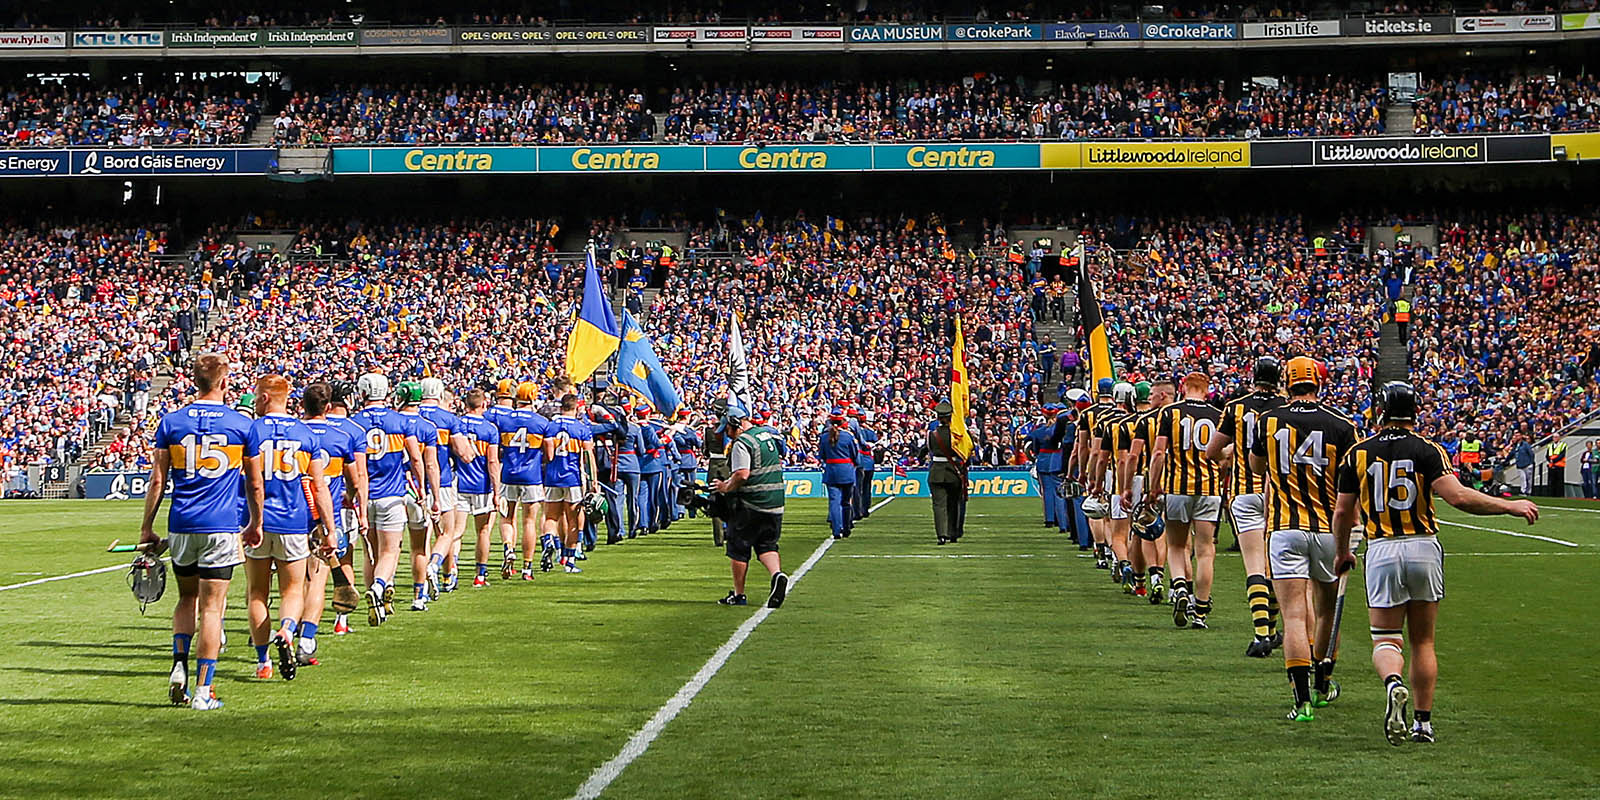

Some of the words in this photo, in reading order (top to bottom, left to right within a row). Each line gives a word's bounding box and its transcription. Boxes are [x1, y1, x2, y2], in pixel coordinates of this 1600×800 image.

[955, 26, 1032, 39] @CrokePark
[1146, 24, 1232, 38] @CrokePark
[1264, 24, 1292, 36] Irish
[1295, 22, 1319, 35] Life
[1365, 19, 1431, 33] tickets.ie
[171, 33, 193, 42] Irish
[194, 32, 249, 44] Independent
[268, 32, 290, 42] Irish
[290, 31, 346, 43] Independent
[461, 32, 483, 40] OPEL
[491, 32, 513, 40] OPEL
[521, 31, 543, 40] OPEL
[555, 31, 578, 40] OPEL
[586, 31, 608, 40] OPEL
[616, 31, 638, 39] OPEL
[816, 30, 840, 38] sports
[851, 28, 882, 40] GAA
[884, 27, 942, 40] MUSEUM
[1099, 29, 1130, 39] Elavon
[9, 156, 59, 171] Energy
[104, 156, 139, 169] Bord
[141, 154, 173, 169] Gáis
[175, 156, 225, 170] Energy
[404, 149, 492, 170] Centra
[571, 148, 659, 170] Centra
[738, 147, 827, 168] Centra
[906, 146, 995, 167] Centra
[509, 427, 530, 454] 4
[1180, 416, 1217, 451] 10
[366, 426, 389, 461] 9
[555, 430, 571, 457] 2
[180, 434, 230, 480] 15
[1273, 427, 1329, 476] 14
[258, 439, 302, 481] 13
[50, 466, 59, 480] 8
[1366, 459, 1418, 512] 15
